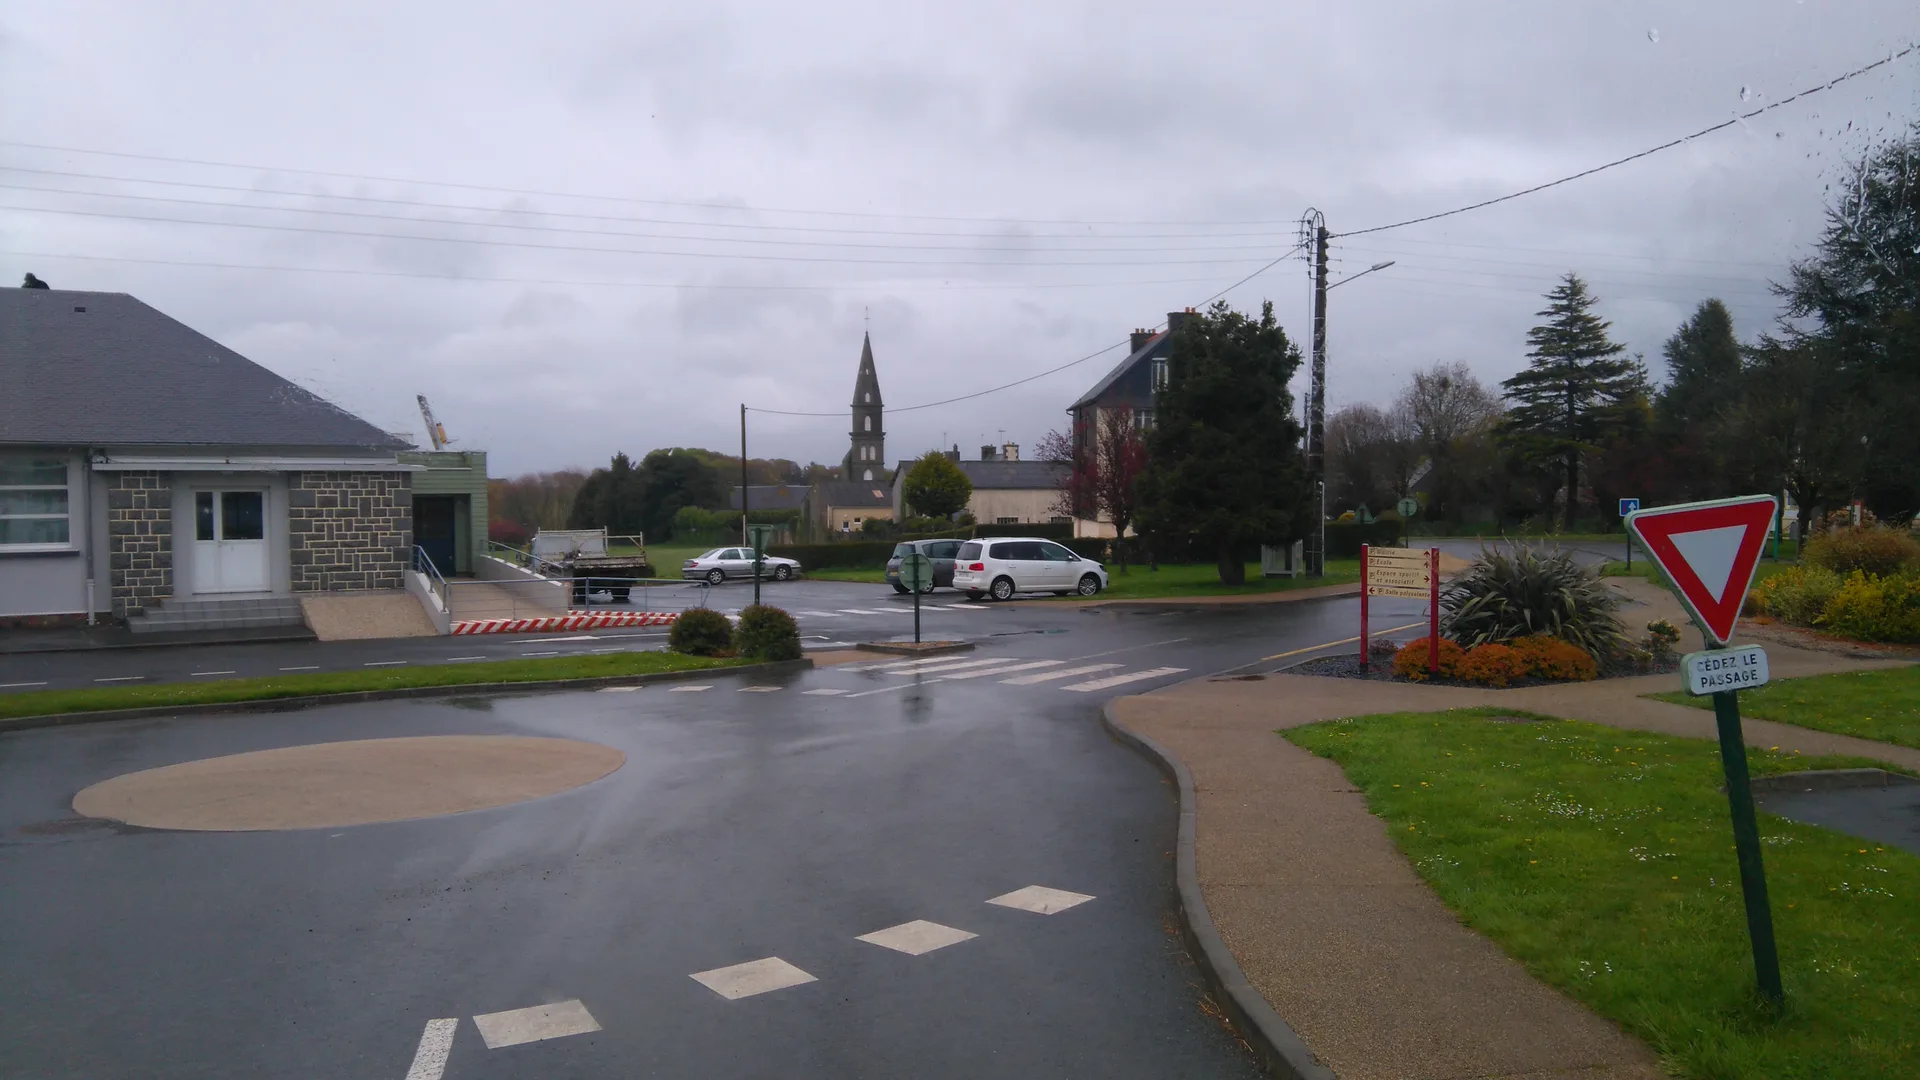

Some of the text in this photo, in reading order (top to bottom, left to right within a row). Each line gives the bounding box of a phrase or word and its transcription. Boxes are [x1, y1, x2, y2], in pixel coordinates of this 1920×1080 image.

[1376, 569, 1396, 577] Espace
[1399, 590, 1431, 598] polyvalente
[1743, 653, 1758, 666] LE
[1700, 669, 1758, 688] PASSAGE
